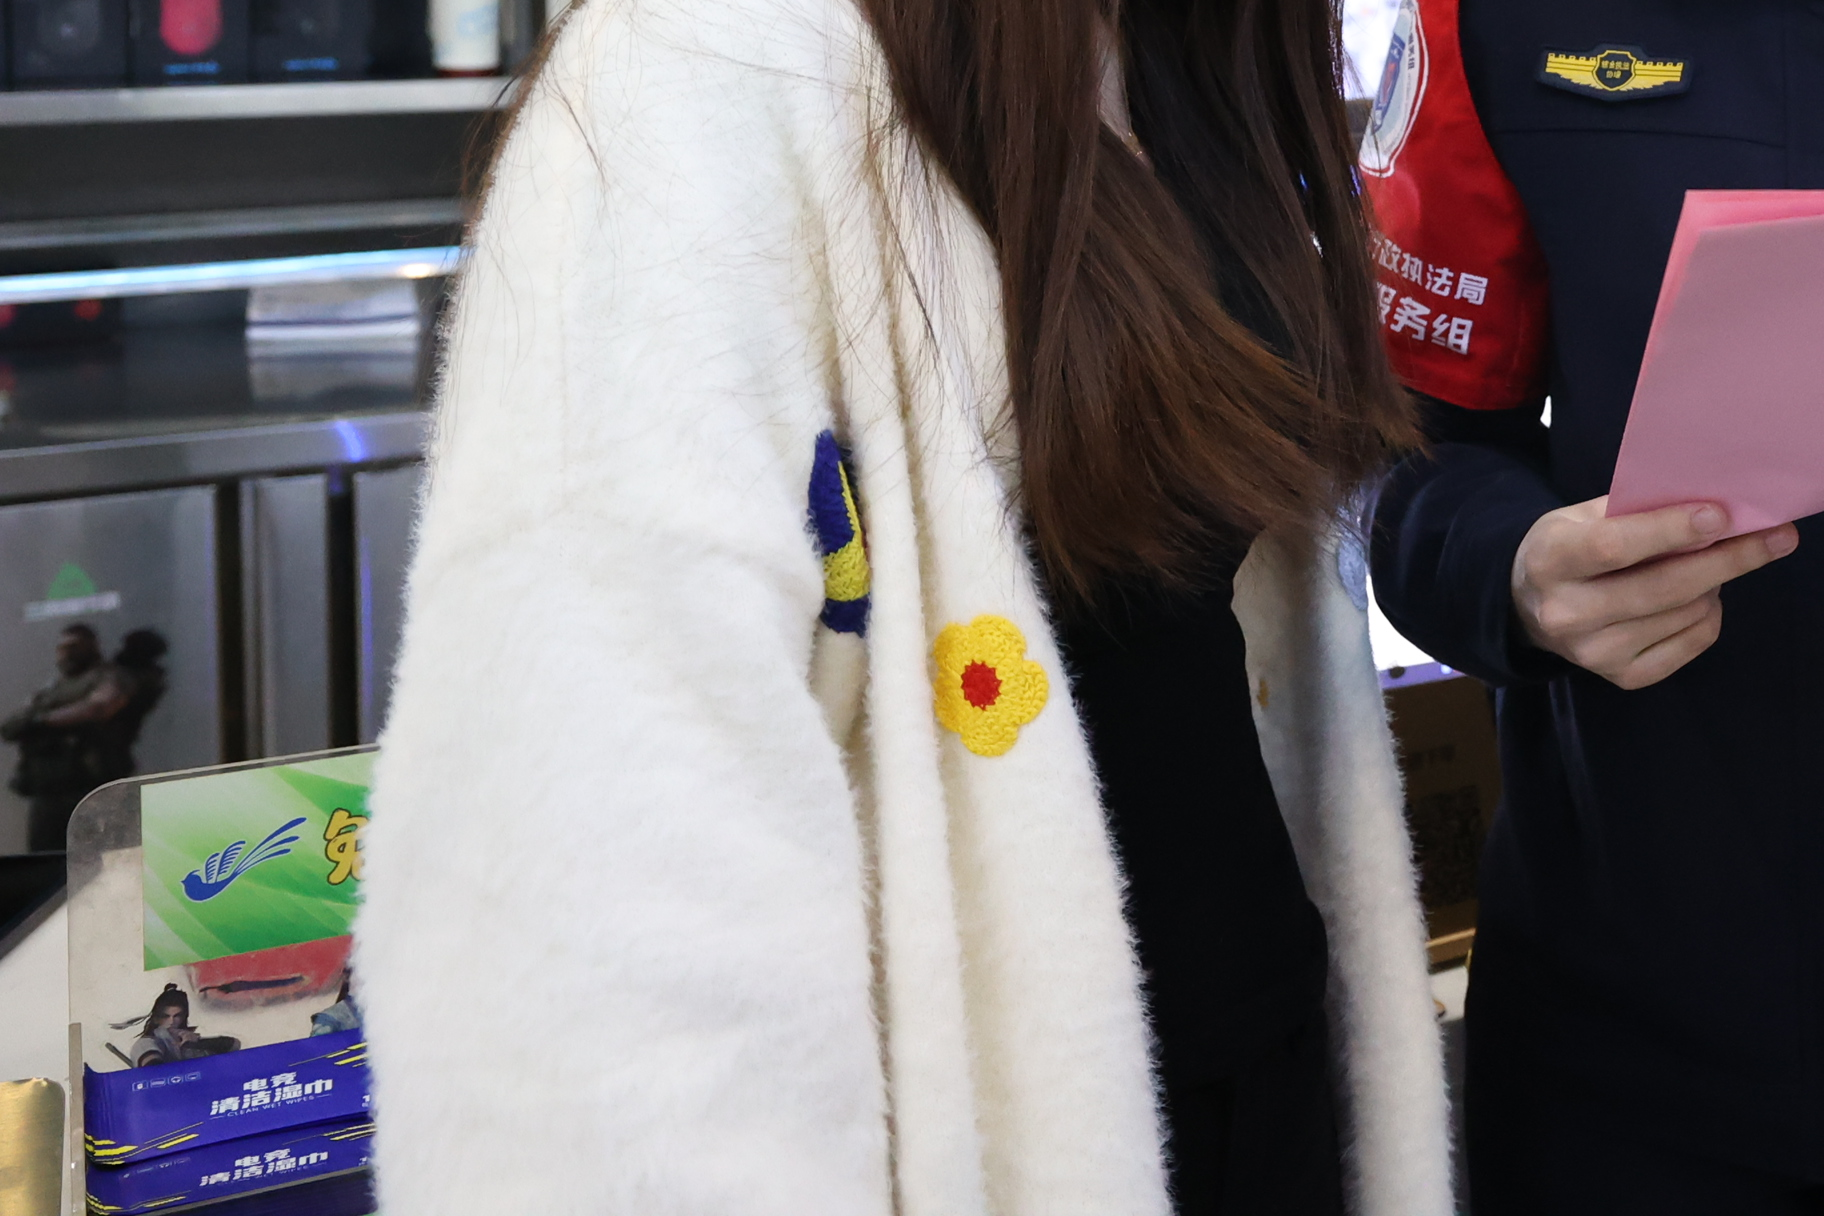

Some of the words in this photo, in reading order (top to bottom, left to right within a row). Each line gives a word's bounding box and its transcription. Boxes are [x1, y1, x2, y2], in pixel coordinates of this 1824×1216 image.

[243, 1071, 297, 1092] 电竞
[209, 1078, 333, 1116] 清洁湿巾
[226, 1107, 259, 1117] CLEAN
[262, 1101, 282, 1110] WET
[286, 1094, 315, 1106] WIPES
[200, 1151, 329, 1187] 清洁湿巾
[234, 1148, 291, 1167] 电竞
